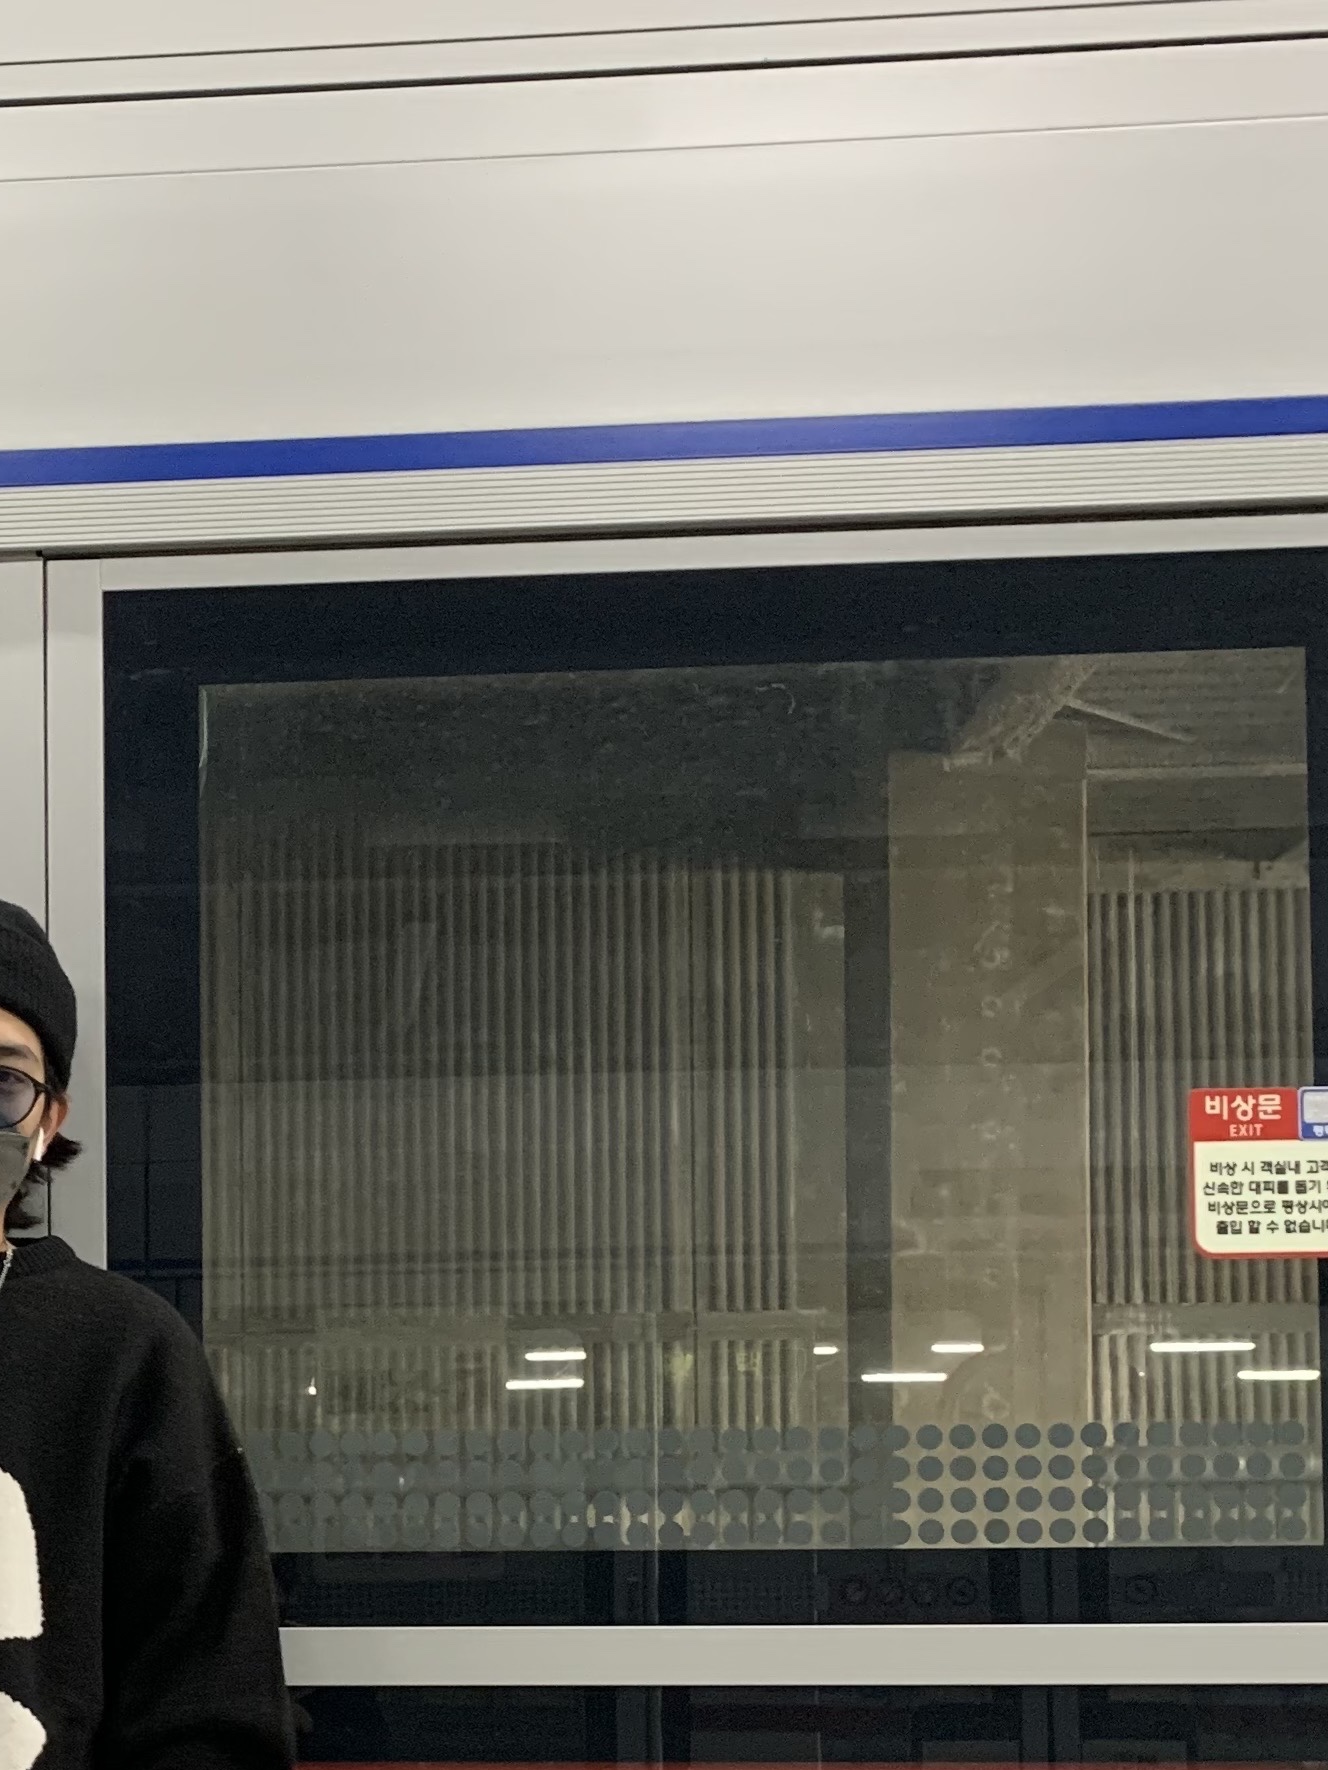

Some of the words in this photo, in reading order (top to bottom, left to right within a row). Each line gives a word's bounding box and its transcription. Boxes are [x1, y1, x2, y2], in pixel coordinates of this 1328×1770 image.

[1204, 1093, 1282, 1121] 비상문
[1229, 1123, 1264, 1137] EXIT
[1209, 1161, 1237, 1176] 비상
[1242, 1161, 1255, 1175] 시
[1203, 1180, 1244, 1195] 신속한
[1207, 1200, 1276, 1215] 비상문으로
[1266, 1220, 1279, 1233] 수
